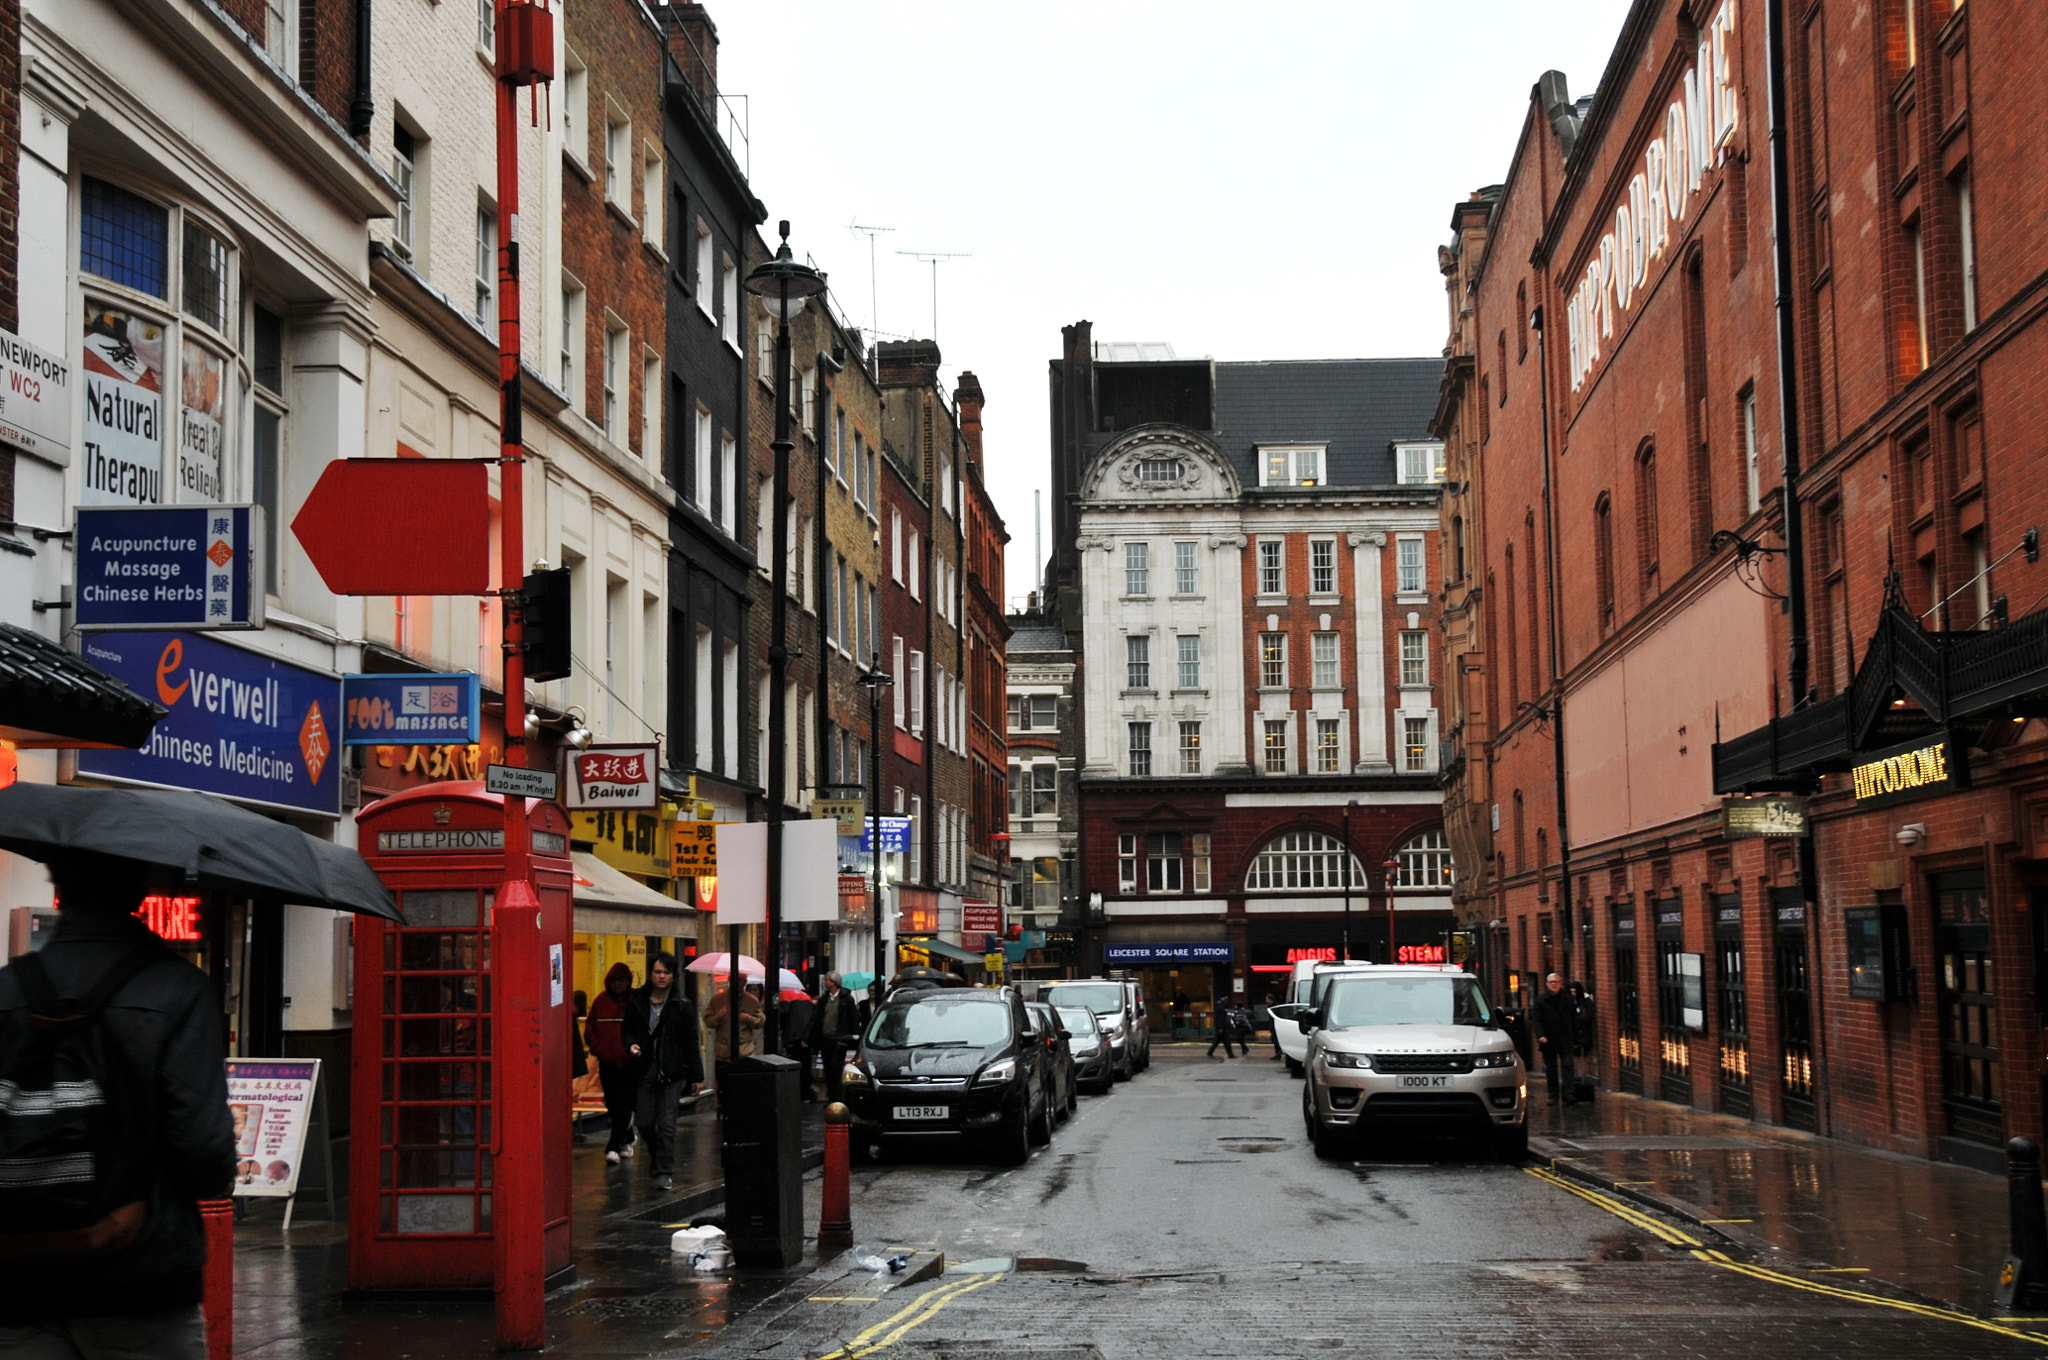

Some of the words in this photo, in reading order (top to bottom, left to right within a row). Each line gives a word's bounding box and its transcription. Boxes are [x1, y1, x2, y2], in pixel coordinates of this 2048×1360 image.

[1567, 0, 1738, 393] HIPPODROME
[0, 336, 67, 388] NEWPORT
[10, 369, 41, 402] WC2
[87, 378, 158, 441] Natural
[181, 407, 210, 457] Treat
[91, 536, 197, 556] Acupuncture
[104, 561, 181, 581] Massage
[83, 585, 150, 602] Chinese
[154, 584, 204, 601] Herbs
[87, 644, 122, 664] Acupuncture
[405, 691, 456, 710] 足浴
[395, 716, 468, 730] MASSAGE
[305, 705, 325, 775] 泰
[140, 726, 213, 768] hinese
[219, 738, 294, 784] Medicine
[503, 770, 514, 779] No
[515, 772, 543, 784] loading
[1852, 743, 1949, 800] HIPPODROME
[490, 780, 509, 790] 8.30
[588, 785, 640, 800] Baiwei
[384, 831, 502, 849] TELEPHONE
[675, 843, 699, 854] 1st
[706, 844, 716, 855] C
[675, 856, 700, 864] Hair
[703, 857, 717, 865] Sa
[839, 888, 863, 896] ASSAGE
[1109, 949, 1151, 957] LEICESTER
[1286, 947, 1337, 963] ANGUS
[1398, 946, 1443, 961] STEAK
[1432, 1076, 1447, 1086] KT
[229, 1093, 304, 1102] ermatological
[899, 1107, 922, 1118] LT13
[923, 1107, 943, 1118] RXJ
